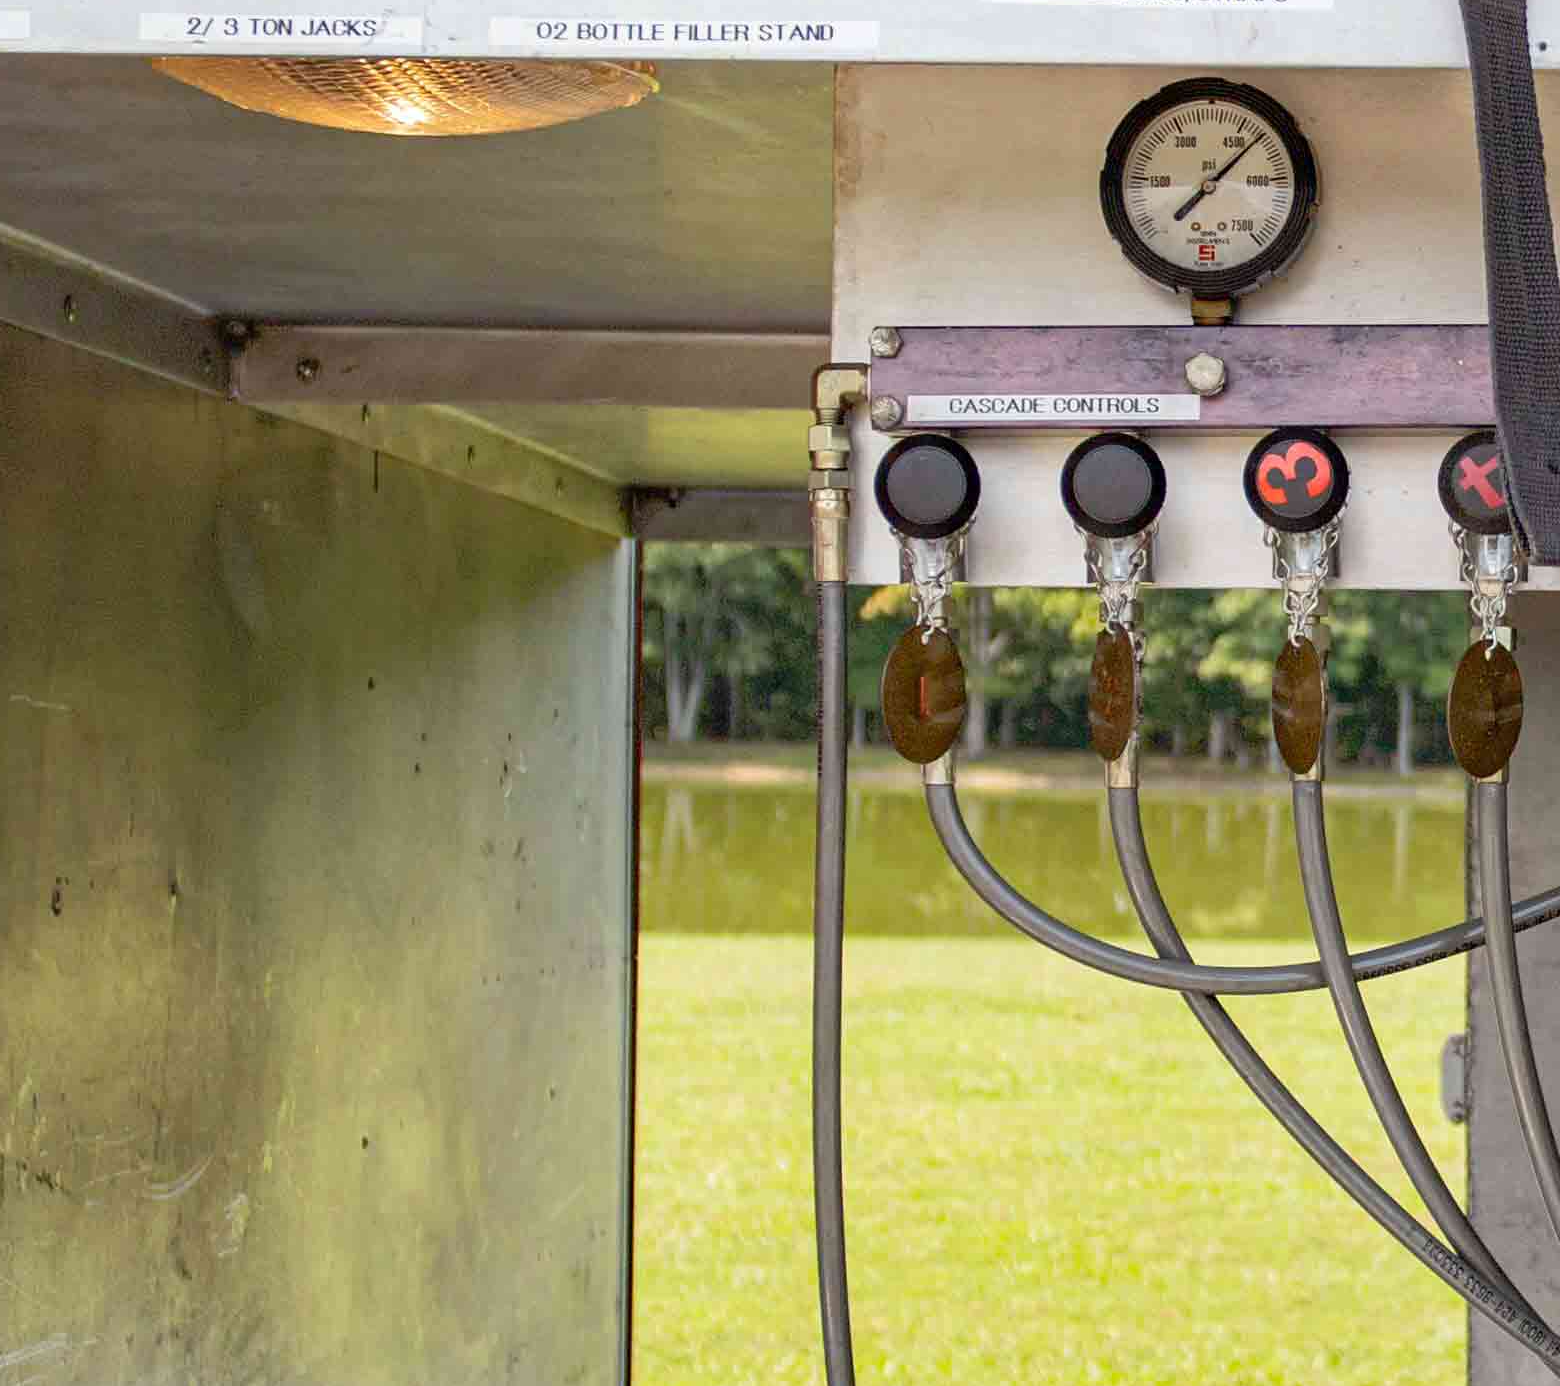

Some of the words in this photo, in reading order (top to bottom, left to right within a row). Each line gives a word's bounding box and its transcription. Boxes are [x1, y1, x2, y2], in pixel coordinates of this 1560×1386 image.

[223, 17, 240, 37] 3
[248, 18, 293, 37] TON
[300, 18, 378, 38] JACKS
[576, 21, 665, 42] BOTTLE
[672, 22, 750, 42] FILLER
[758, 22, 836, 43] STAND
[1175, 136, 1197, 149] 3000
[1223, 136, 1246, 149] 4500
[1149, 176, 1171, 188] 1500
[1246, 175, 1269, 188] 6000
[1231, 219, 1254, 231] 7500
[949, 397, 1048, 414] CASCADE
[1053, 397, 1160, 414] CONTROLS
[1255, 439, 1335, 506] 3
